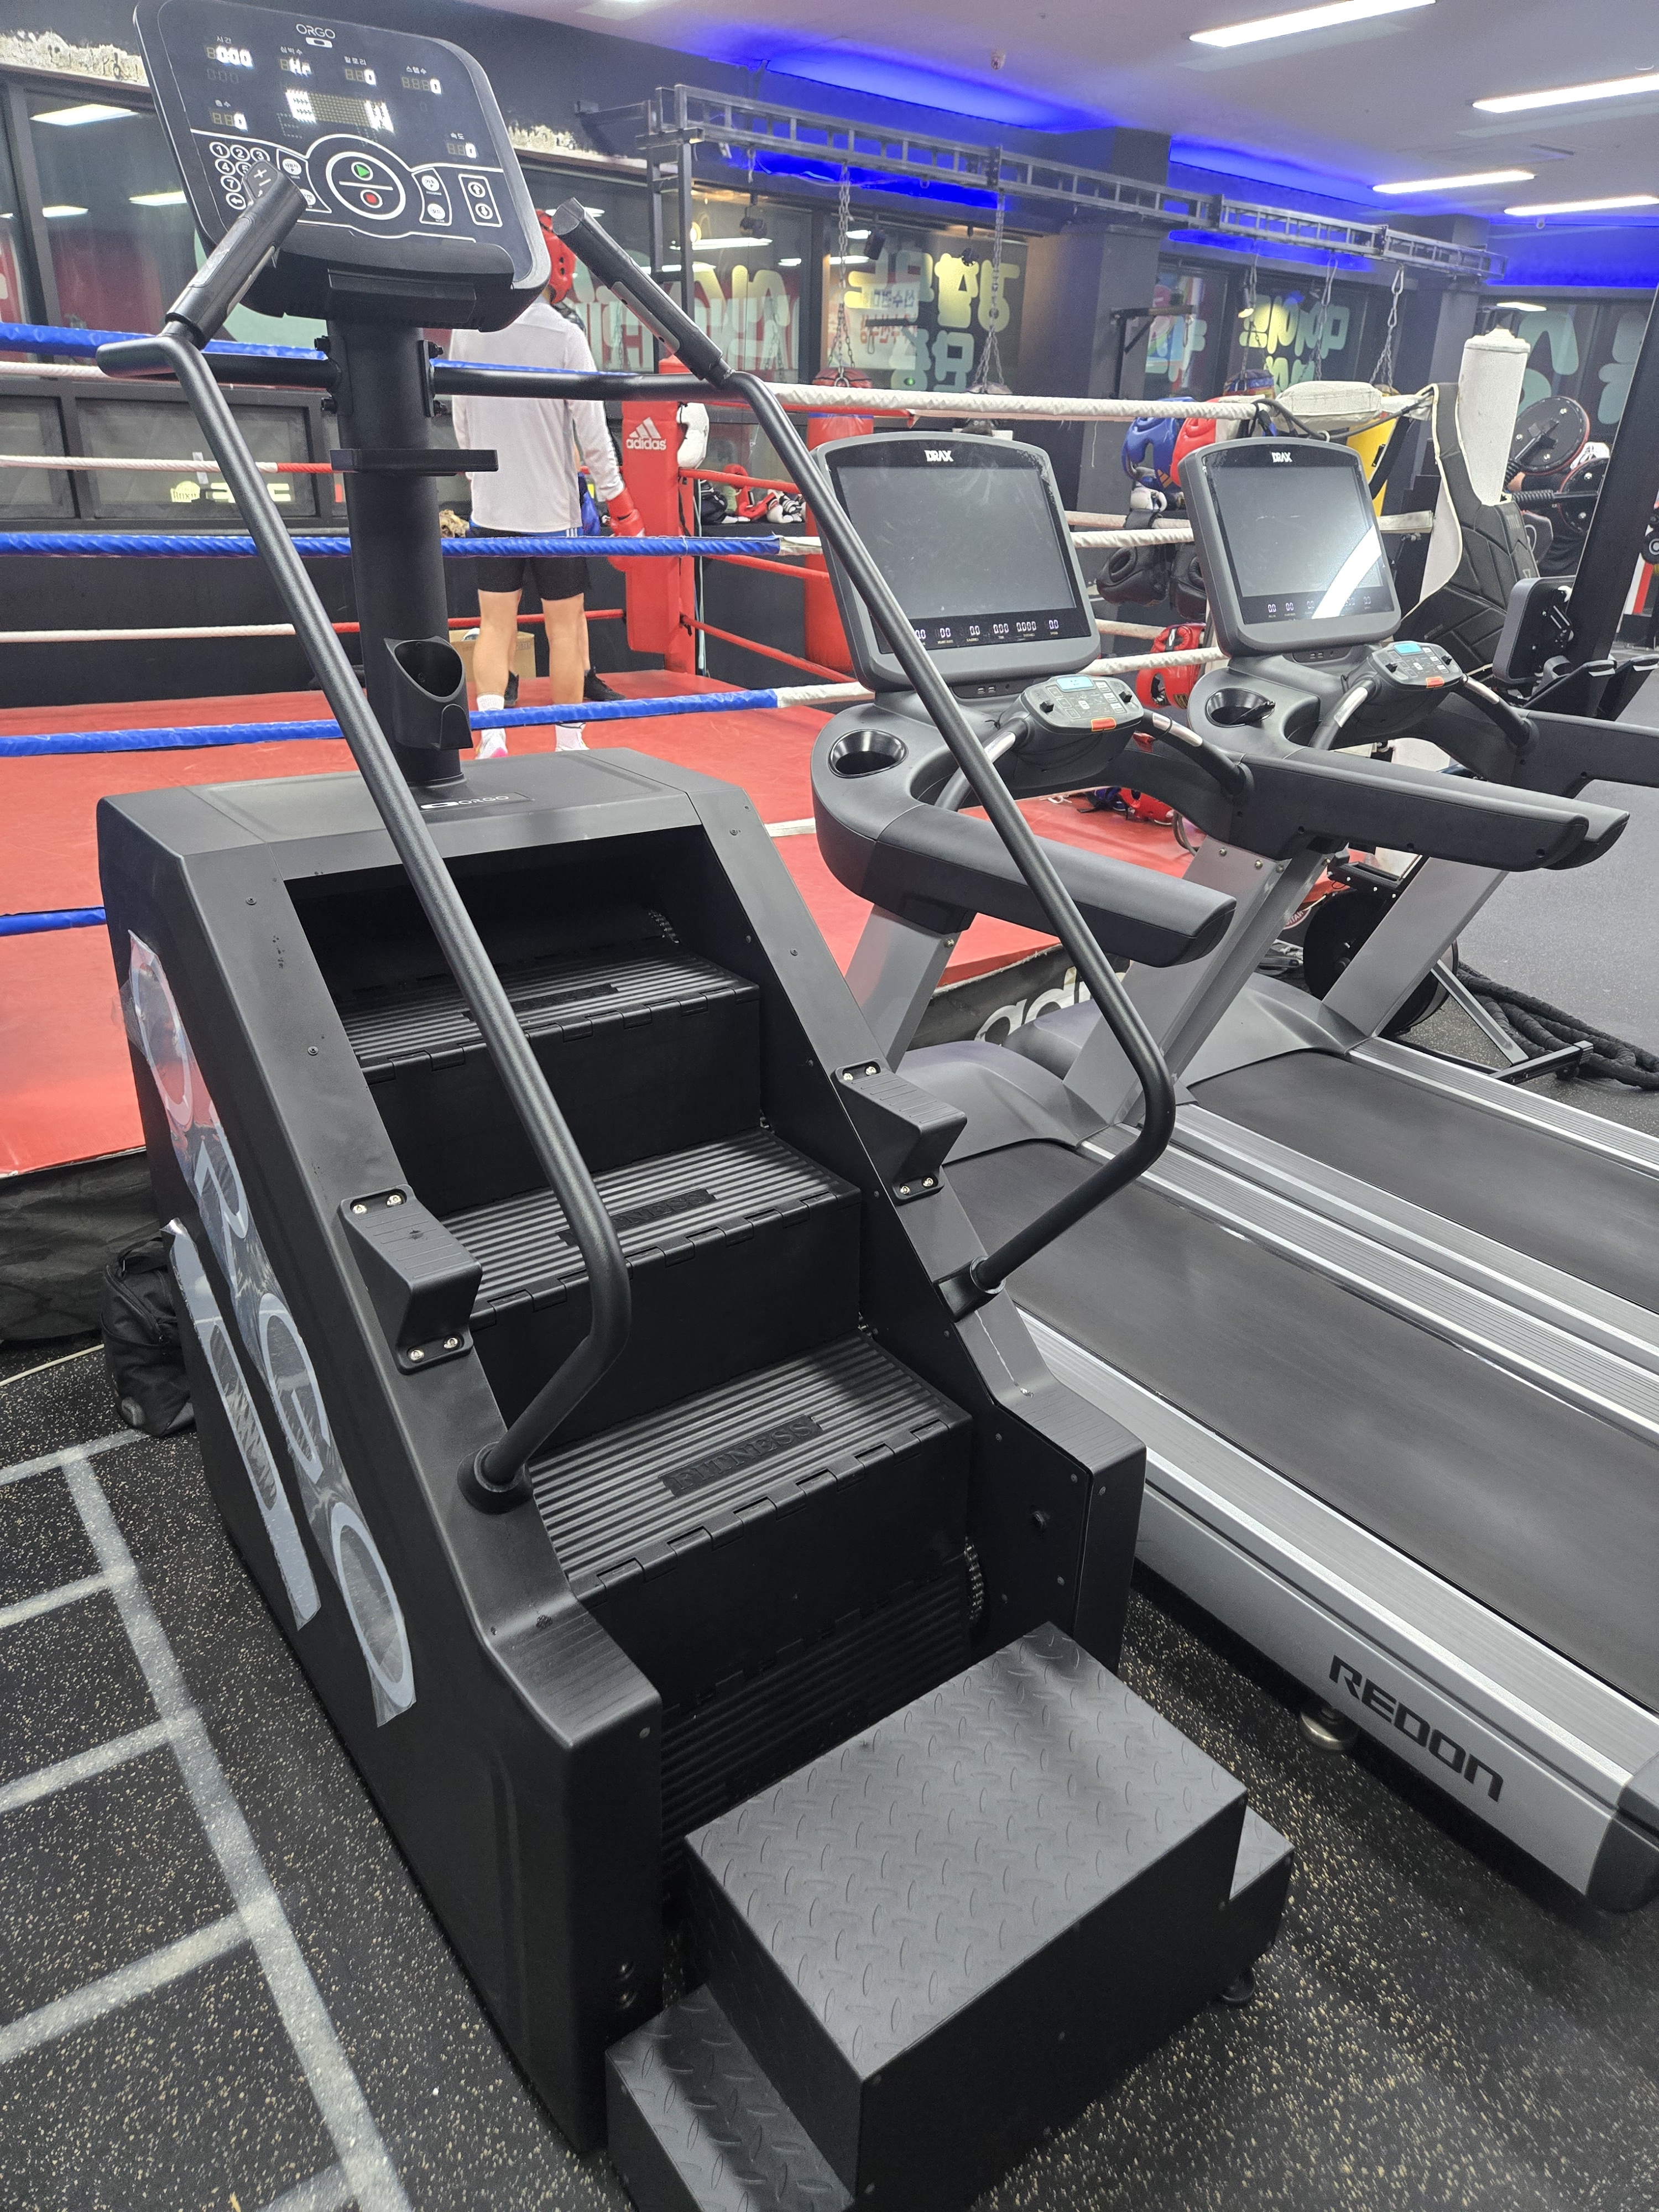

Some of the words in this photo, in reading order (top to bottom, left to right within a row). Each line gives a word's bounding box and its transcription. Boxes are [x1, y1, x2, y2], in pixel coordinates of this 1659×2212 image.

[296, 23, 335, 39] ORGO
[216, 35, 231, 44] 시간
[280, 46, 302, 55] 심박수
[216, 145, 223, 155] 1
[236, 148, 245, 158] 2
[256, 151, 264, 160] 3
[222, 162, 231, 171] 4
[226, 179, 235, 188] 7
[626, 437, 667, 451] adidas
[924, 450, 954, 462] DRAX
[1271, 451, 1293, 463] DRAX
[458, 796, 509, 805] ORGO
[670, 1423, 813, 1490] FITNESS
